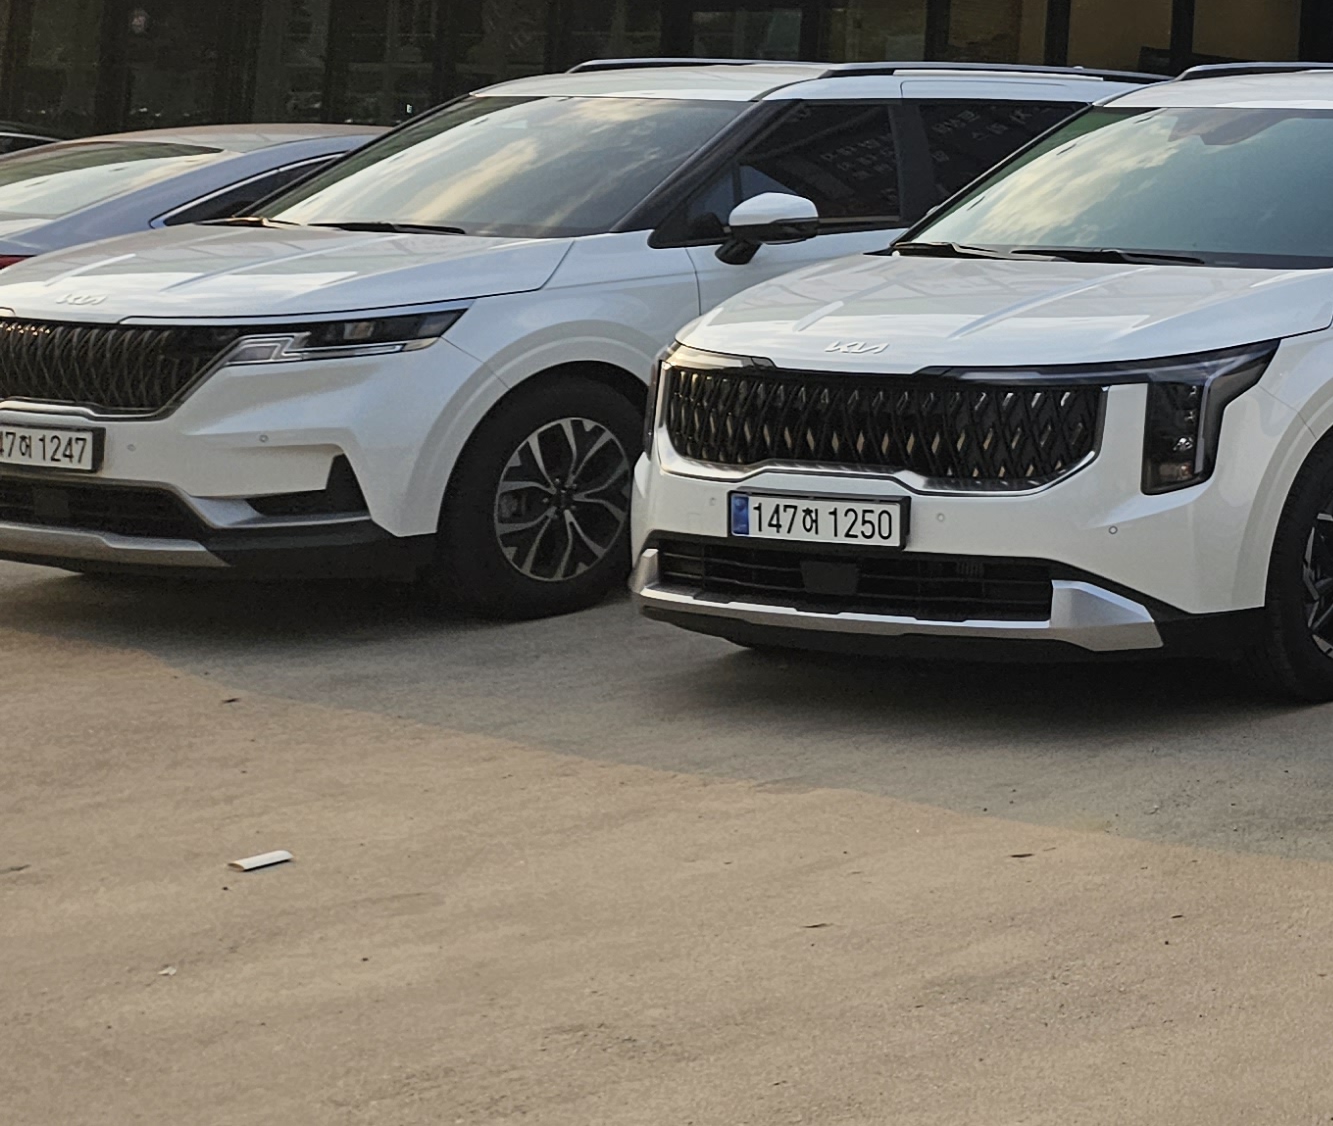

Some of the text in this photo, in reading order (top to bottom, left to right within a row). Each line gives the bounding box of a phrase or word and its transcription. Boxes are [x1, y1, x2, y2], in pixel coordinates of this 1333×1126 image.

[39, 434, 88, 464] 1247
[753, 502, 893, 541] 147허 1250
